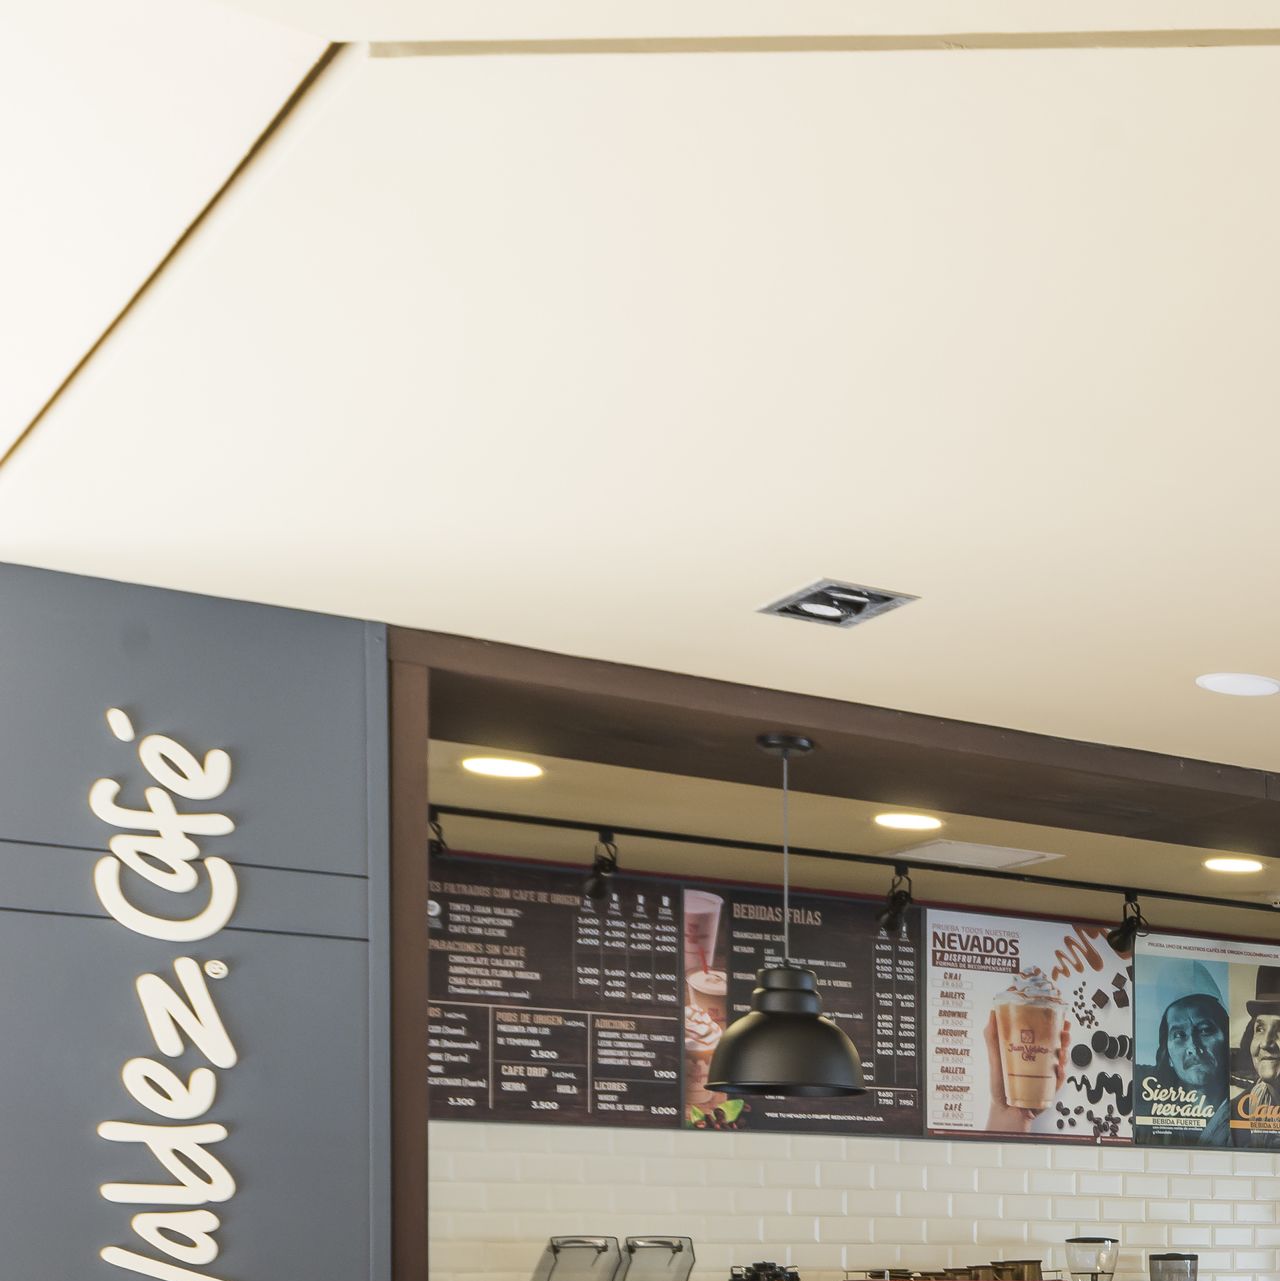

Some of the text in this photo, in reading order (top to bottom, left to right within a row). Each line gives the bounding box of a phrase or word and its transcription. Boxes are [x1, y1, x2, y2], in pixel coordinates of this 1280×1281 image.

[90, 706, 240, 943] Café
[732, 903, 782, 922] BEBIDAS
[931, 923, 1020, 939] PRUEBA TODOS NUESTROS
[932, 930, 1020, 956] NEVADOS
[936, 952, 1017, 968] Y DISFRUTA MUCHAS
[943, 971, 961, 980] CHAI
[940, 990, 965, 1000] BAILEYS
[938, 1009, 968, 1019] BROWNIE
[937, 1028, 968, 1038] AREQUIPE
[530, 1049, 559, 1059] 3.500
[935, 1046, 970, 1056] CHOCOLATE
[526, 1067, 549, 1077] DRIP
[654, 1069, 677, 1079] 1.900
[940, 1065, 966, 1075] GALLETA
[594, 1081, 628, 1092] LICORES
[1142, 1076, 1199, 1103] Sierra
[530, 1100, 560, 1110] 3.500
[944, 1102, 962, 1111] CAFÉ
[1151, 1095, 1215, 1118] nevada
[1176, 1118, 1201, 1126] FUERTE
[1250, 1121, 1272, 1129] BEBIDA
